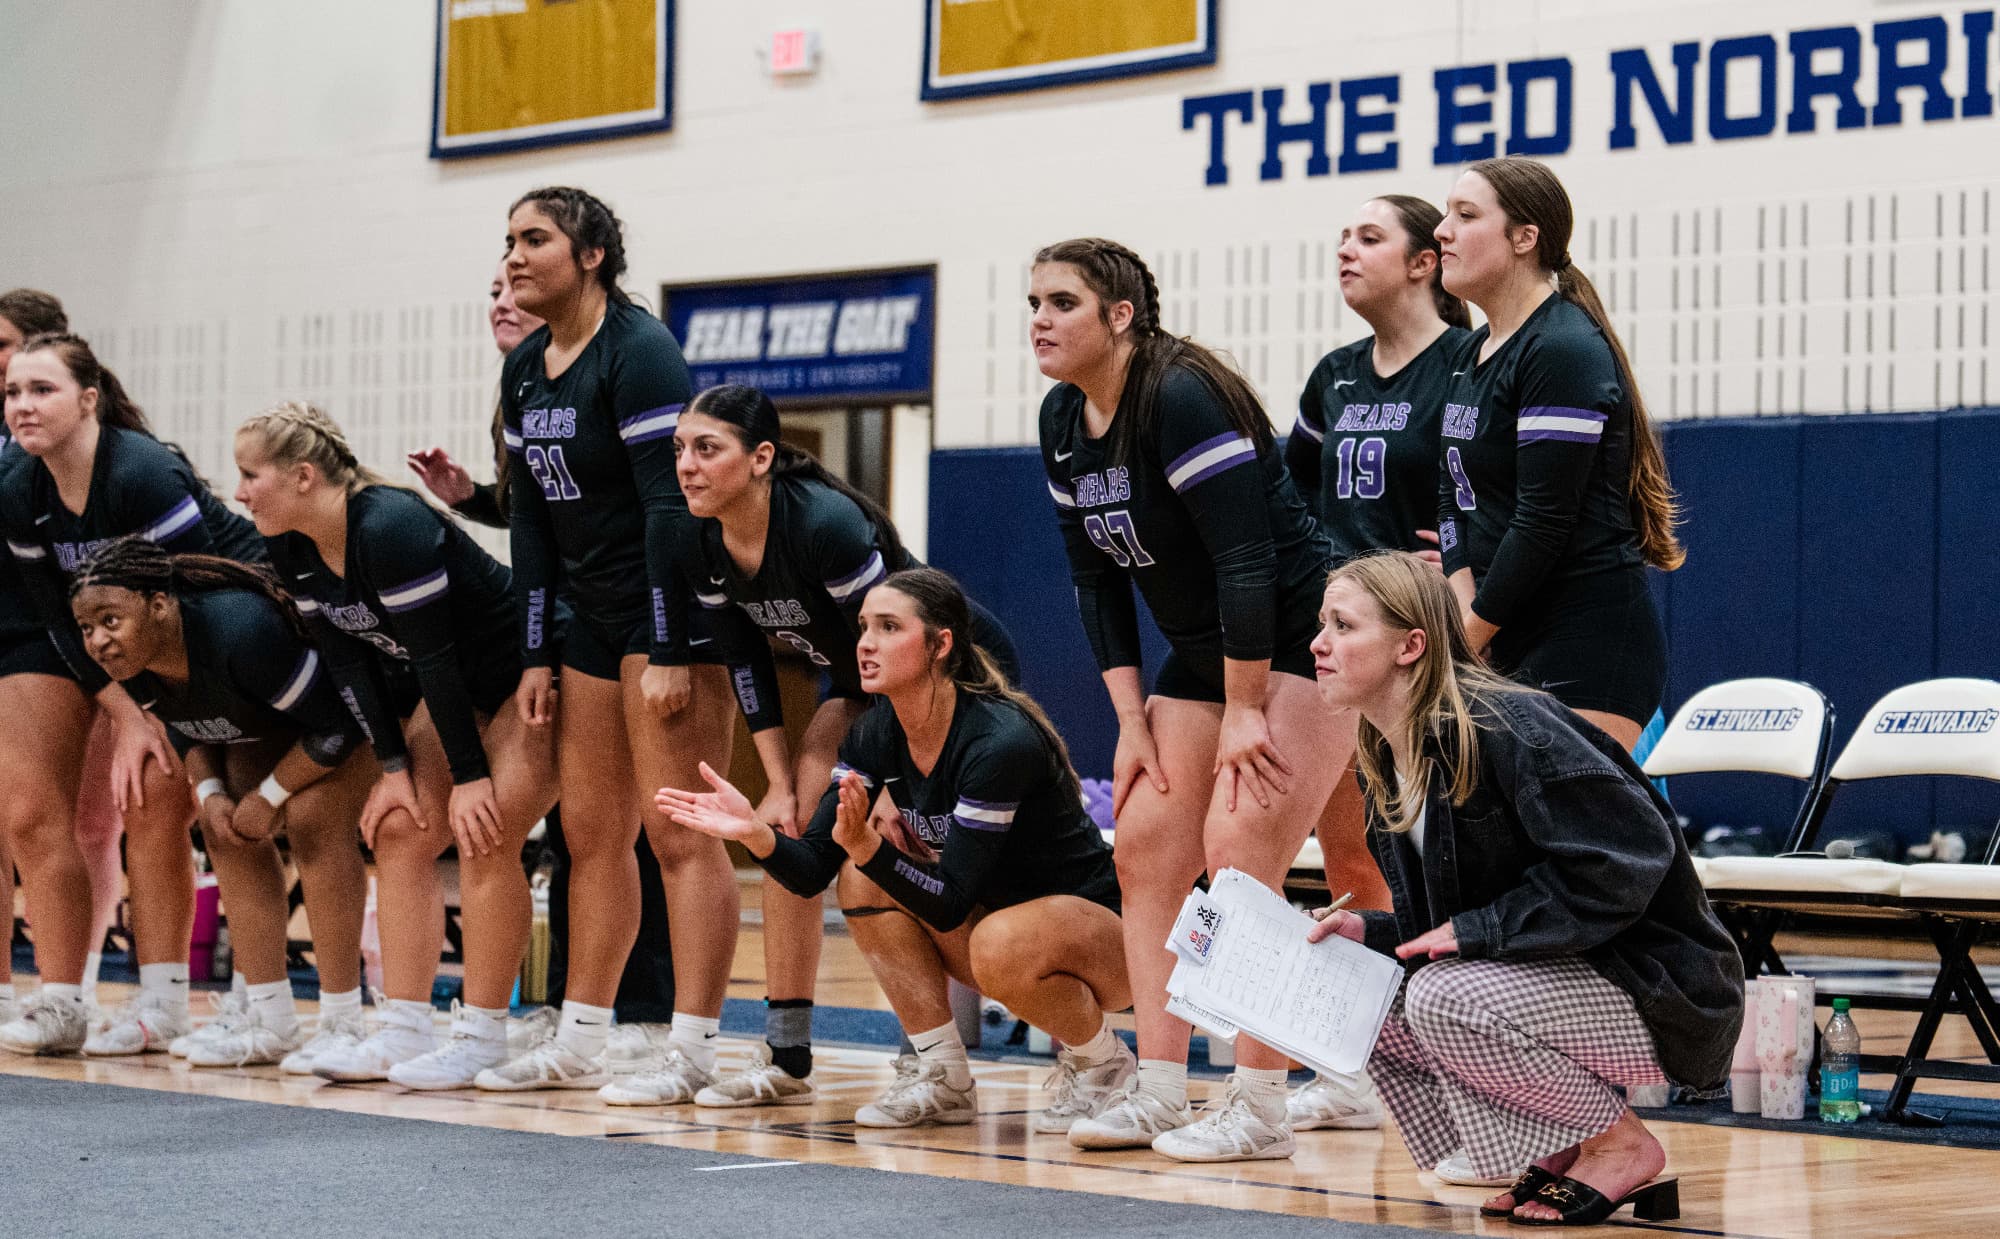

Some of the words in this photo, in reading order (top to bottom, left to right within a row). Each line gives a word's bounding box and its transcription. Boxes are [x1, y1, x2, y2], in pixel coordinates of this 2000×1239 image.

[1182, 75, 1400, 186] THE
[1433, 57, 1573, 166] ED
[1609, 10, 1999, 151] NORRI
[682, 307, 765, 365] FEAR
[766, 302, 836, 360] THE
[835, 294, 921, 357] GOAT
[1334, 402, 1412, 432] BEARS
[526, 445, 582, 500] 21
[1071, 466, 1131, 507] BEARS
[1336, 437, 1387, 499] 19
[1084, 510, 1156, 567] 97
